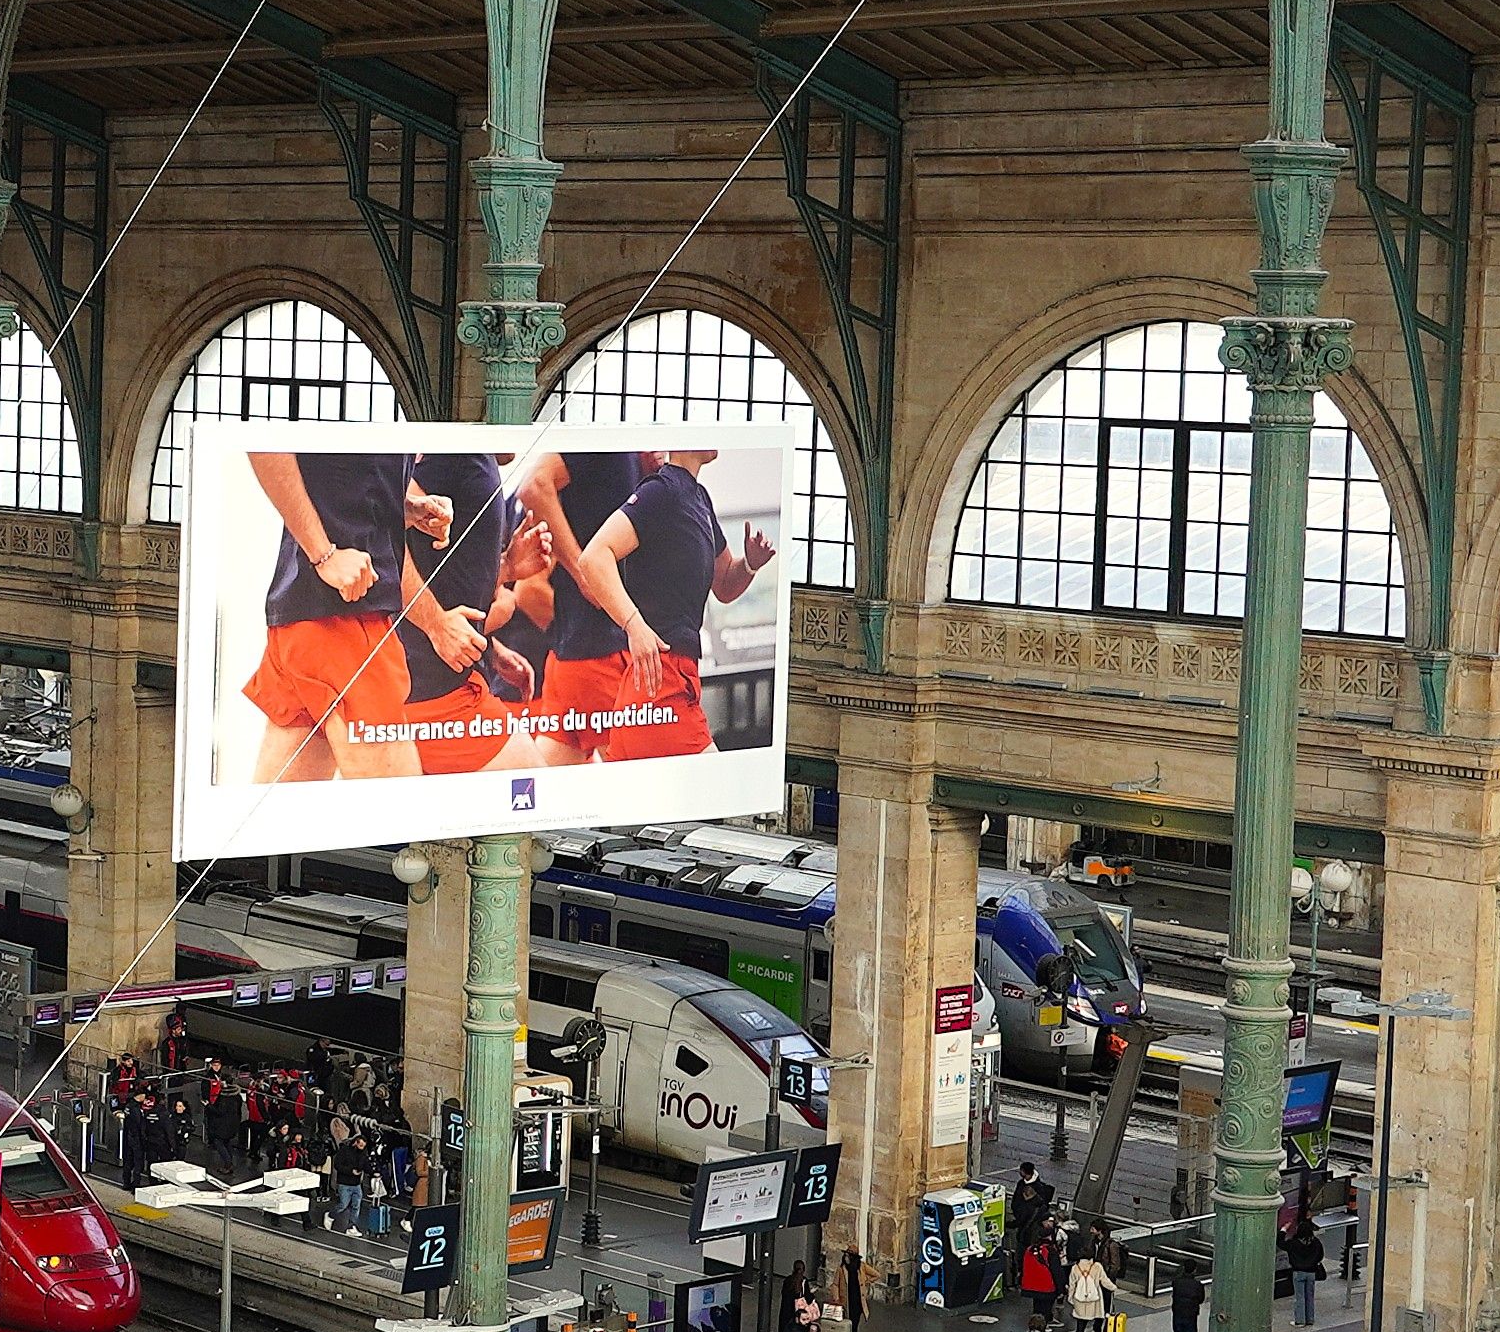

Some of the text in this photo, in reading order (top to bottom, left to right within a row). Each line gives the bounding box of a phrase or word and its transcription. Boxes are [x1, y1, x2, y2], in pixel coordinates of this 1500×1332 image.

[348, 702, 679, 744] L'assurance des héros du quotidien.
[747, 965, 794, 983] PICARDIE
[664, 1078, 685, 1092] TGV
[786, 1074, 806, 1096] 13
[448, 1124, 463, 1147] 12
[804, 1176, 828, 1200] 13
[509, 1199, 554, 1226] EGARDE!
[419, 1237, 446, 1265] 12
